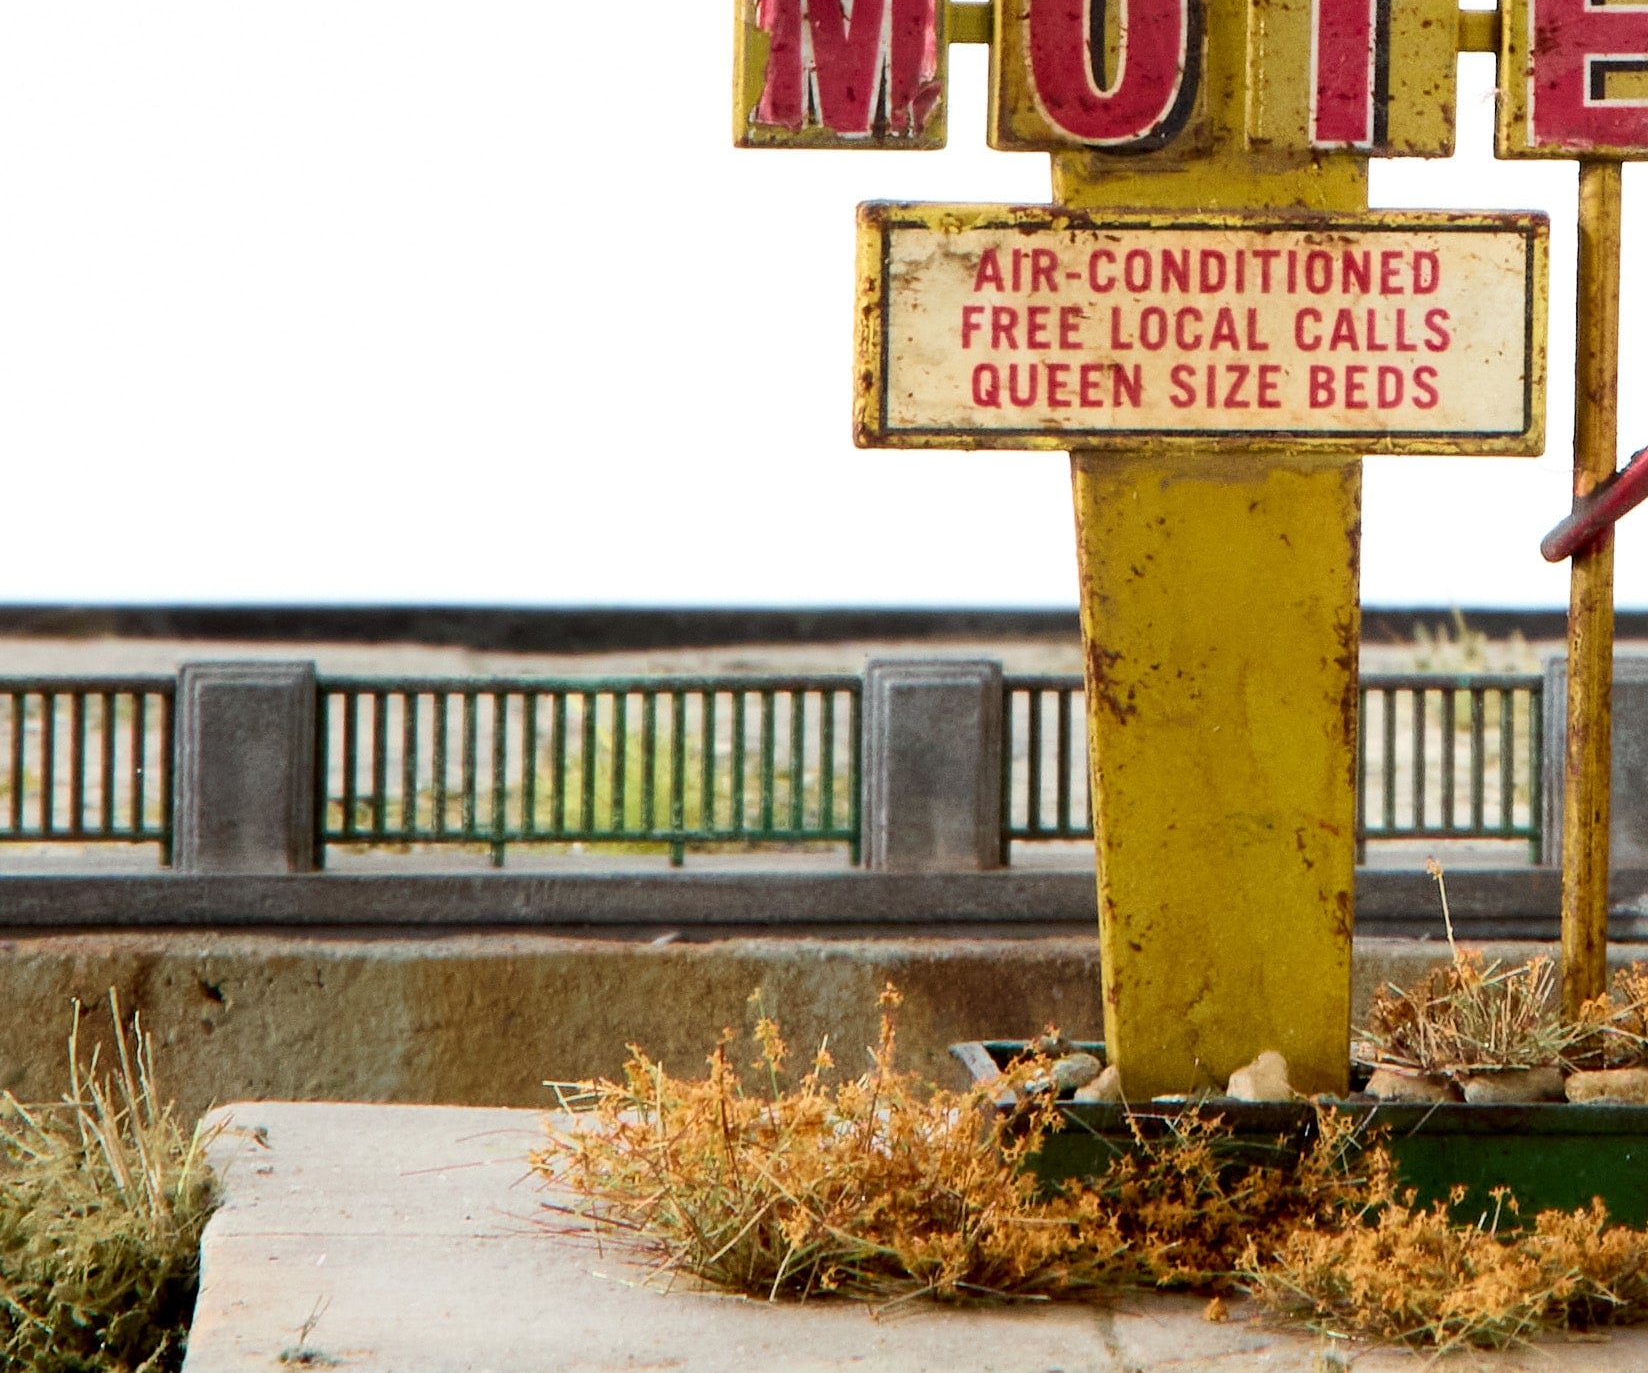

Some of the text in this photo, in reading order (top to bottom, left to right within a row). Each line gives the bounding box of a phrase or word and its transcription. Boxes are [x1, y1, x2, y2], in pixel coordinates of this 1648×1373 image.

[973, 247, 1442, 296] AIR-CONDITIONED
[960, 305, 1451, 353] FREE LOCAL CALLS
[970, 362, 1440, 410] QUEEN SIZE BEDS
